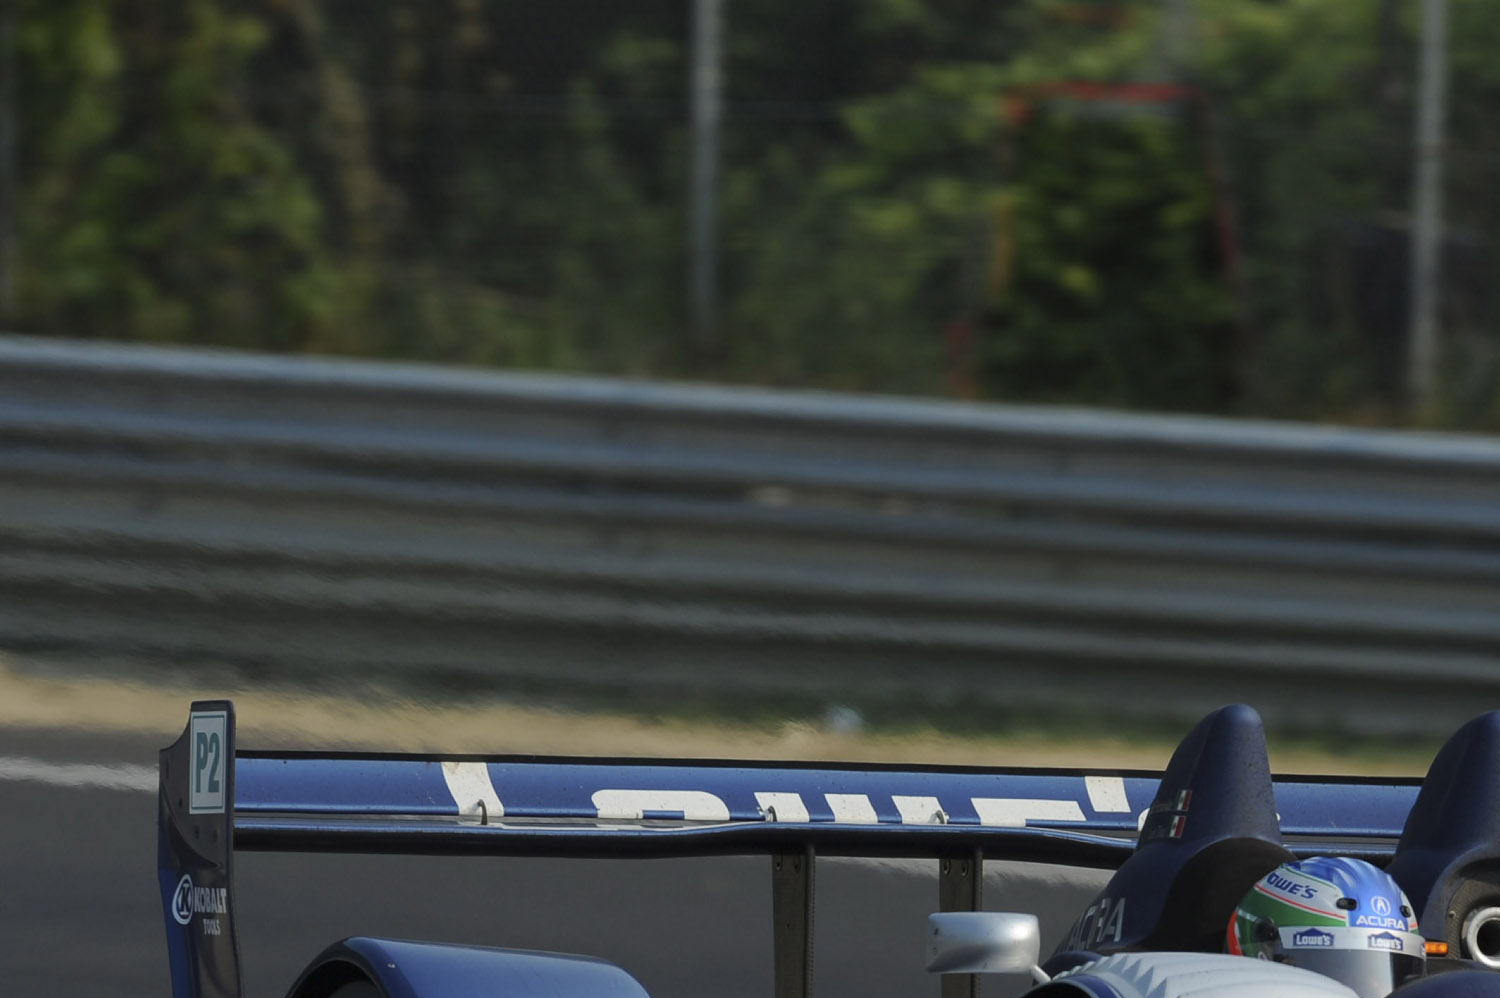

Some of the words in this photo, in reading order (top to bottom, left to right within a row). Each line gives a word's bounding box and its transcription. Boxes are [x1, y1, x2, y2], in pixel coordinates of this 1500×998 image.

[195, 732, 220, 793] P2
[1266, 872, 1318, 899] OWE'S
[194, 886, 227, 914] KOBALT
[203, 918, 221, 936] TOOLS
[1356, 915, 1406, 930] ACURA
